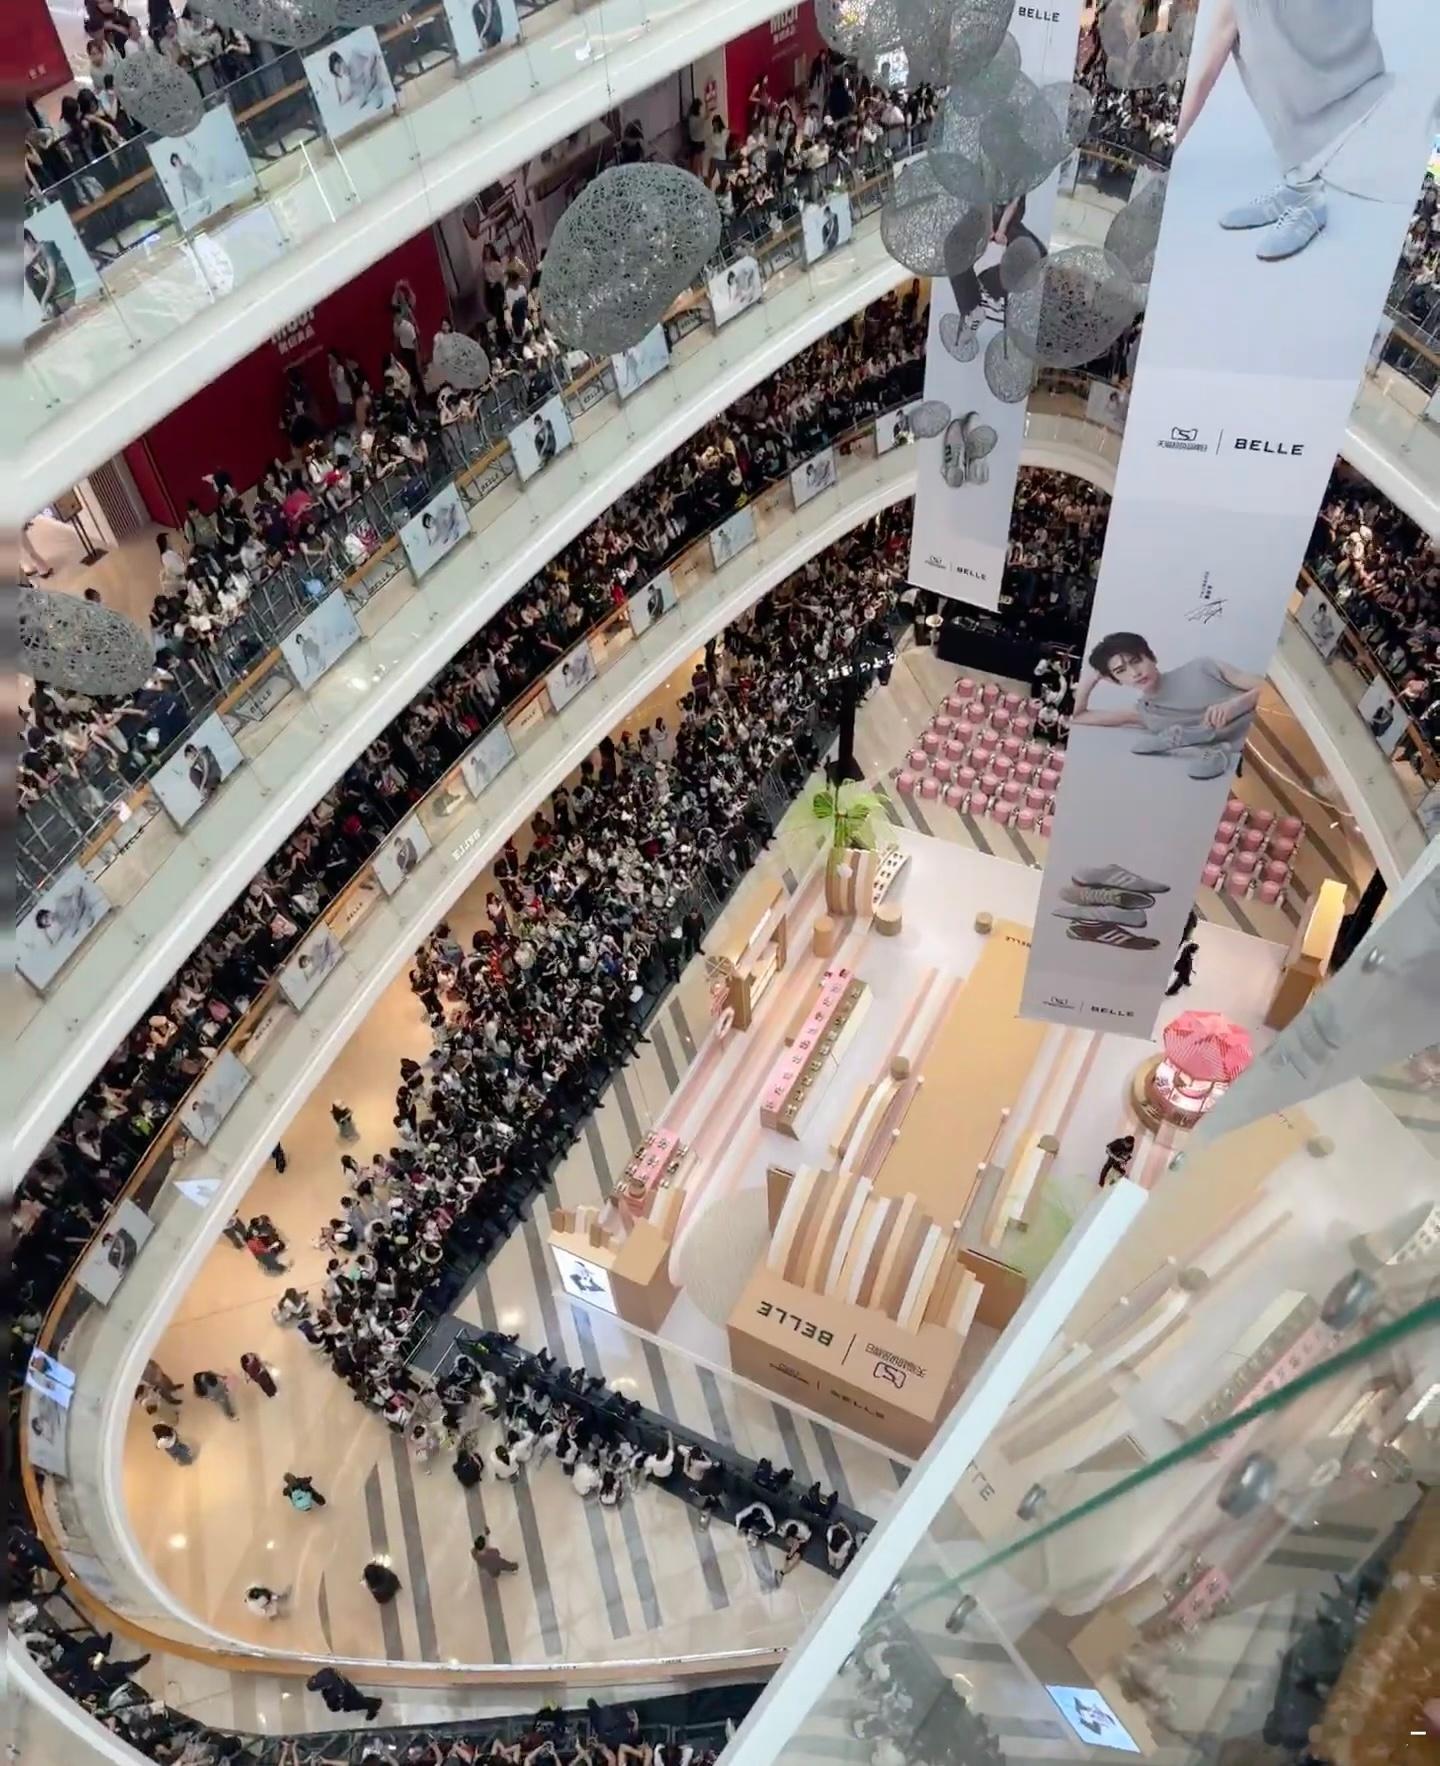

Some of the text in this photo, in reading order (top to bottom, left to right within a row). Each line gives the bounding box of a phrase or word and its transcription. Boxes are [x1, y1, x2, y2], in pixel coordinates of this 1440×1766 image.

[1018, 6, 1060, 23] BELLE
[1234, 438, 1304, 456] BELLE
[756, 1301, 834, 1347] BELLE
